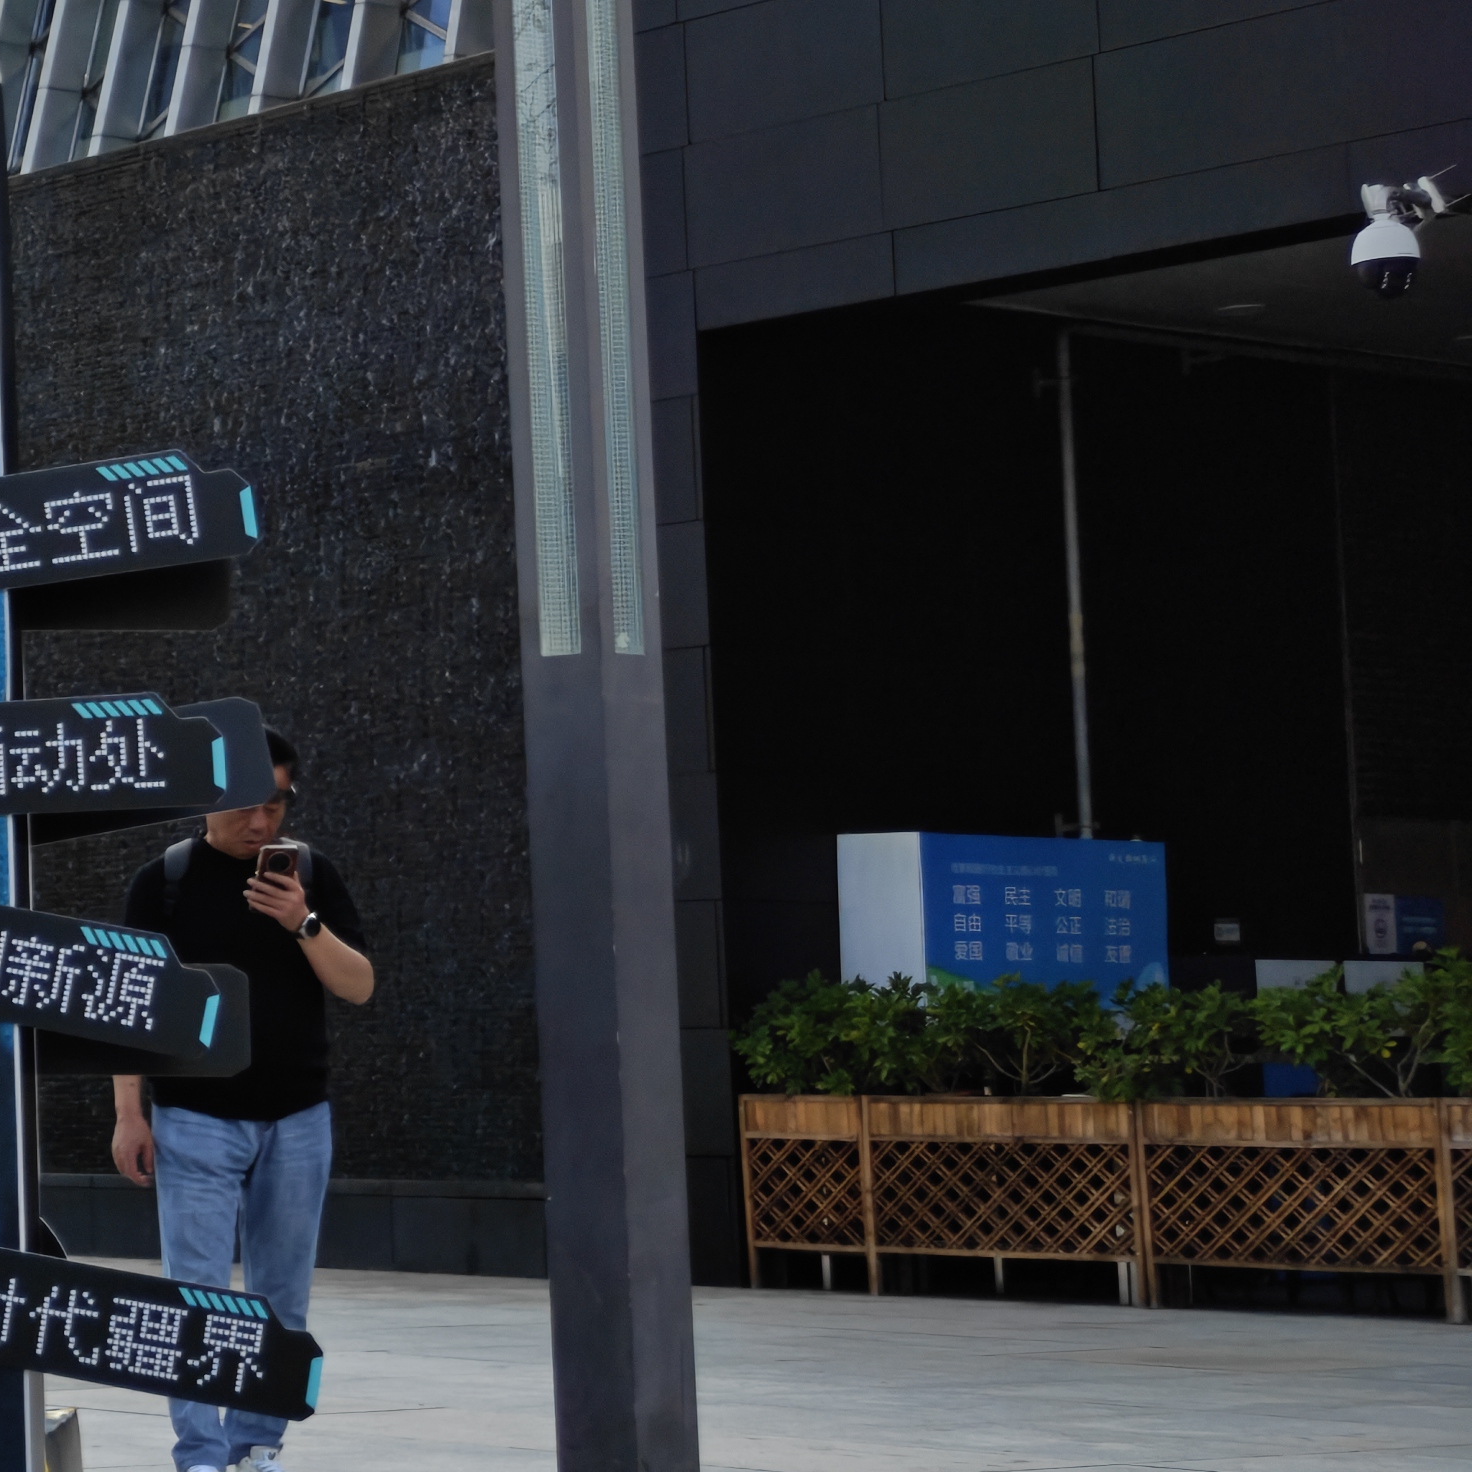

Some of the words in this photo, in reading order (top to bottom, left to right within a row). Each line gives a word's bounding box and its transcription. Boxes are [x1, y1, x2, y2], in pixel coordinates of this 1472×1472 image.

[1005, 886, 1031, 906] 民主
[1054, 888, 1082, 908] 文明
[954, 913, 981, 932] 自由
[1005, 914, 1032, 934] 平等
[1056, 915, 1082, 935] 公正
[954, 940, 983, 960] 爱国
